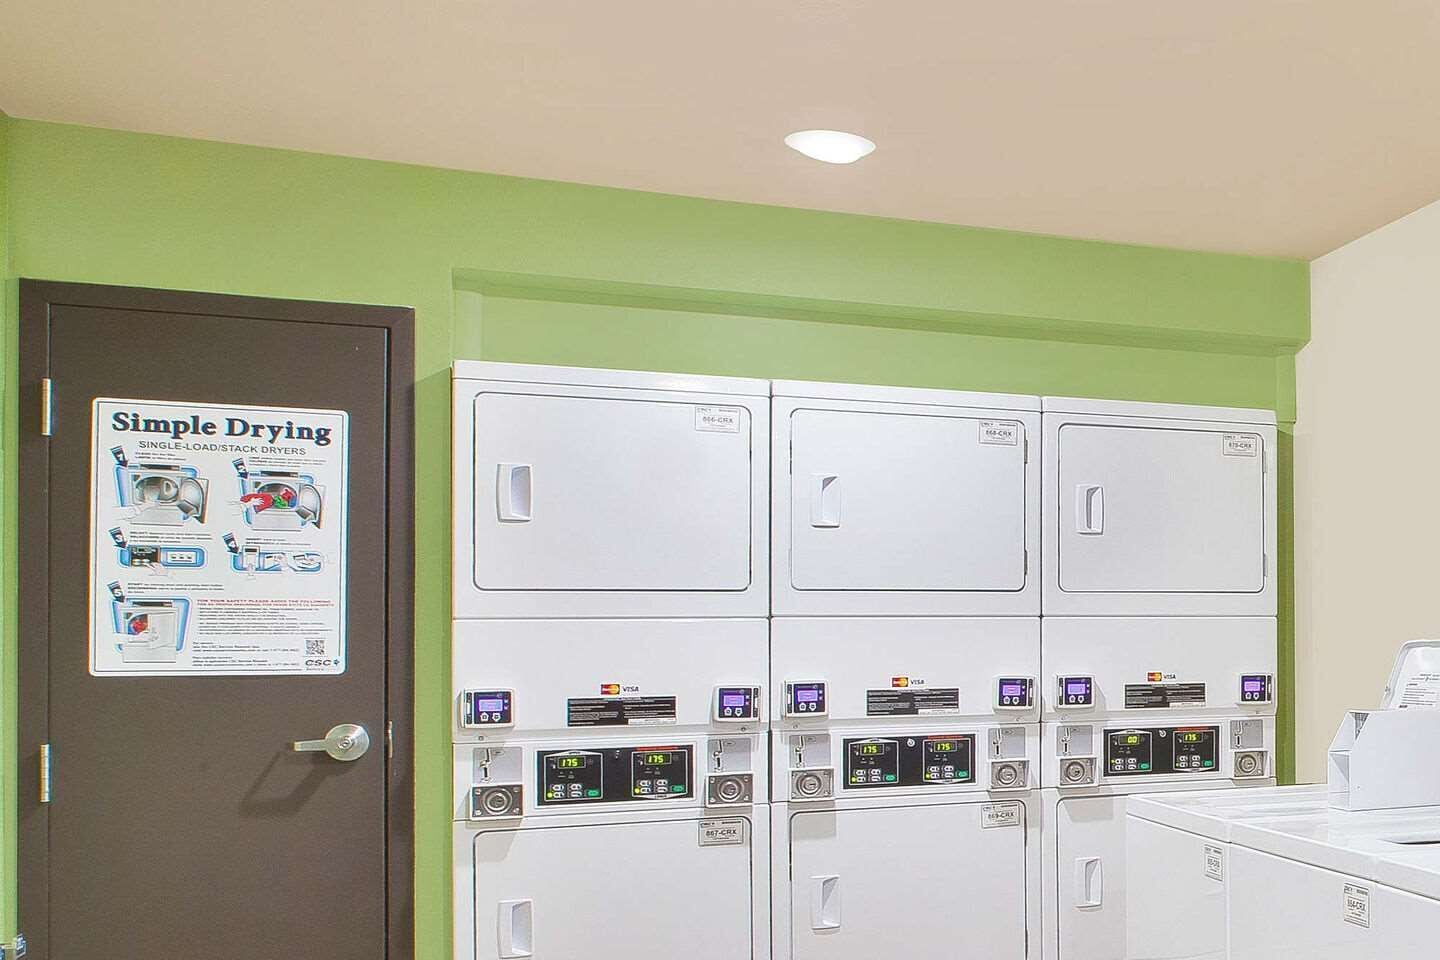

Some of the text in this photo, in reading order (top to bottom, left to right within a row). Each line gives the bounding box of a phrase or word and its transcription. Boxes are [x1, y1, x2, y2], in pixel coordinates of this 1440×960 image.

[112, 411, 333, 446] Simple Drying
[138, 440, 307, 455] SINGLE-LOAD/STACK DRYERS
[1184, 732, 1197, 741] 175
[863, 744, 877, 753] 175
[936, 742, 951, 751] 175
[562, 759, 578, 767] 175
[648, 755, 664, 763] 175
